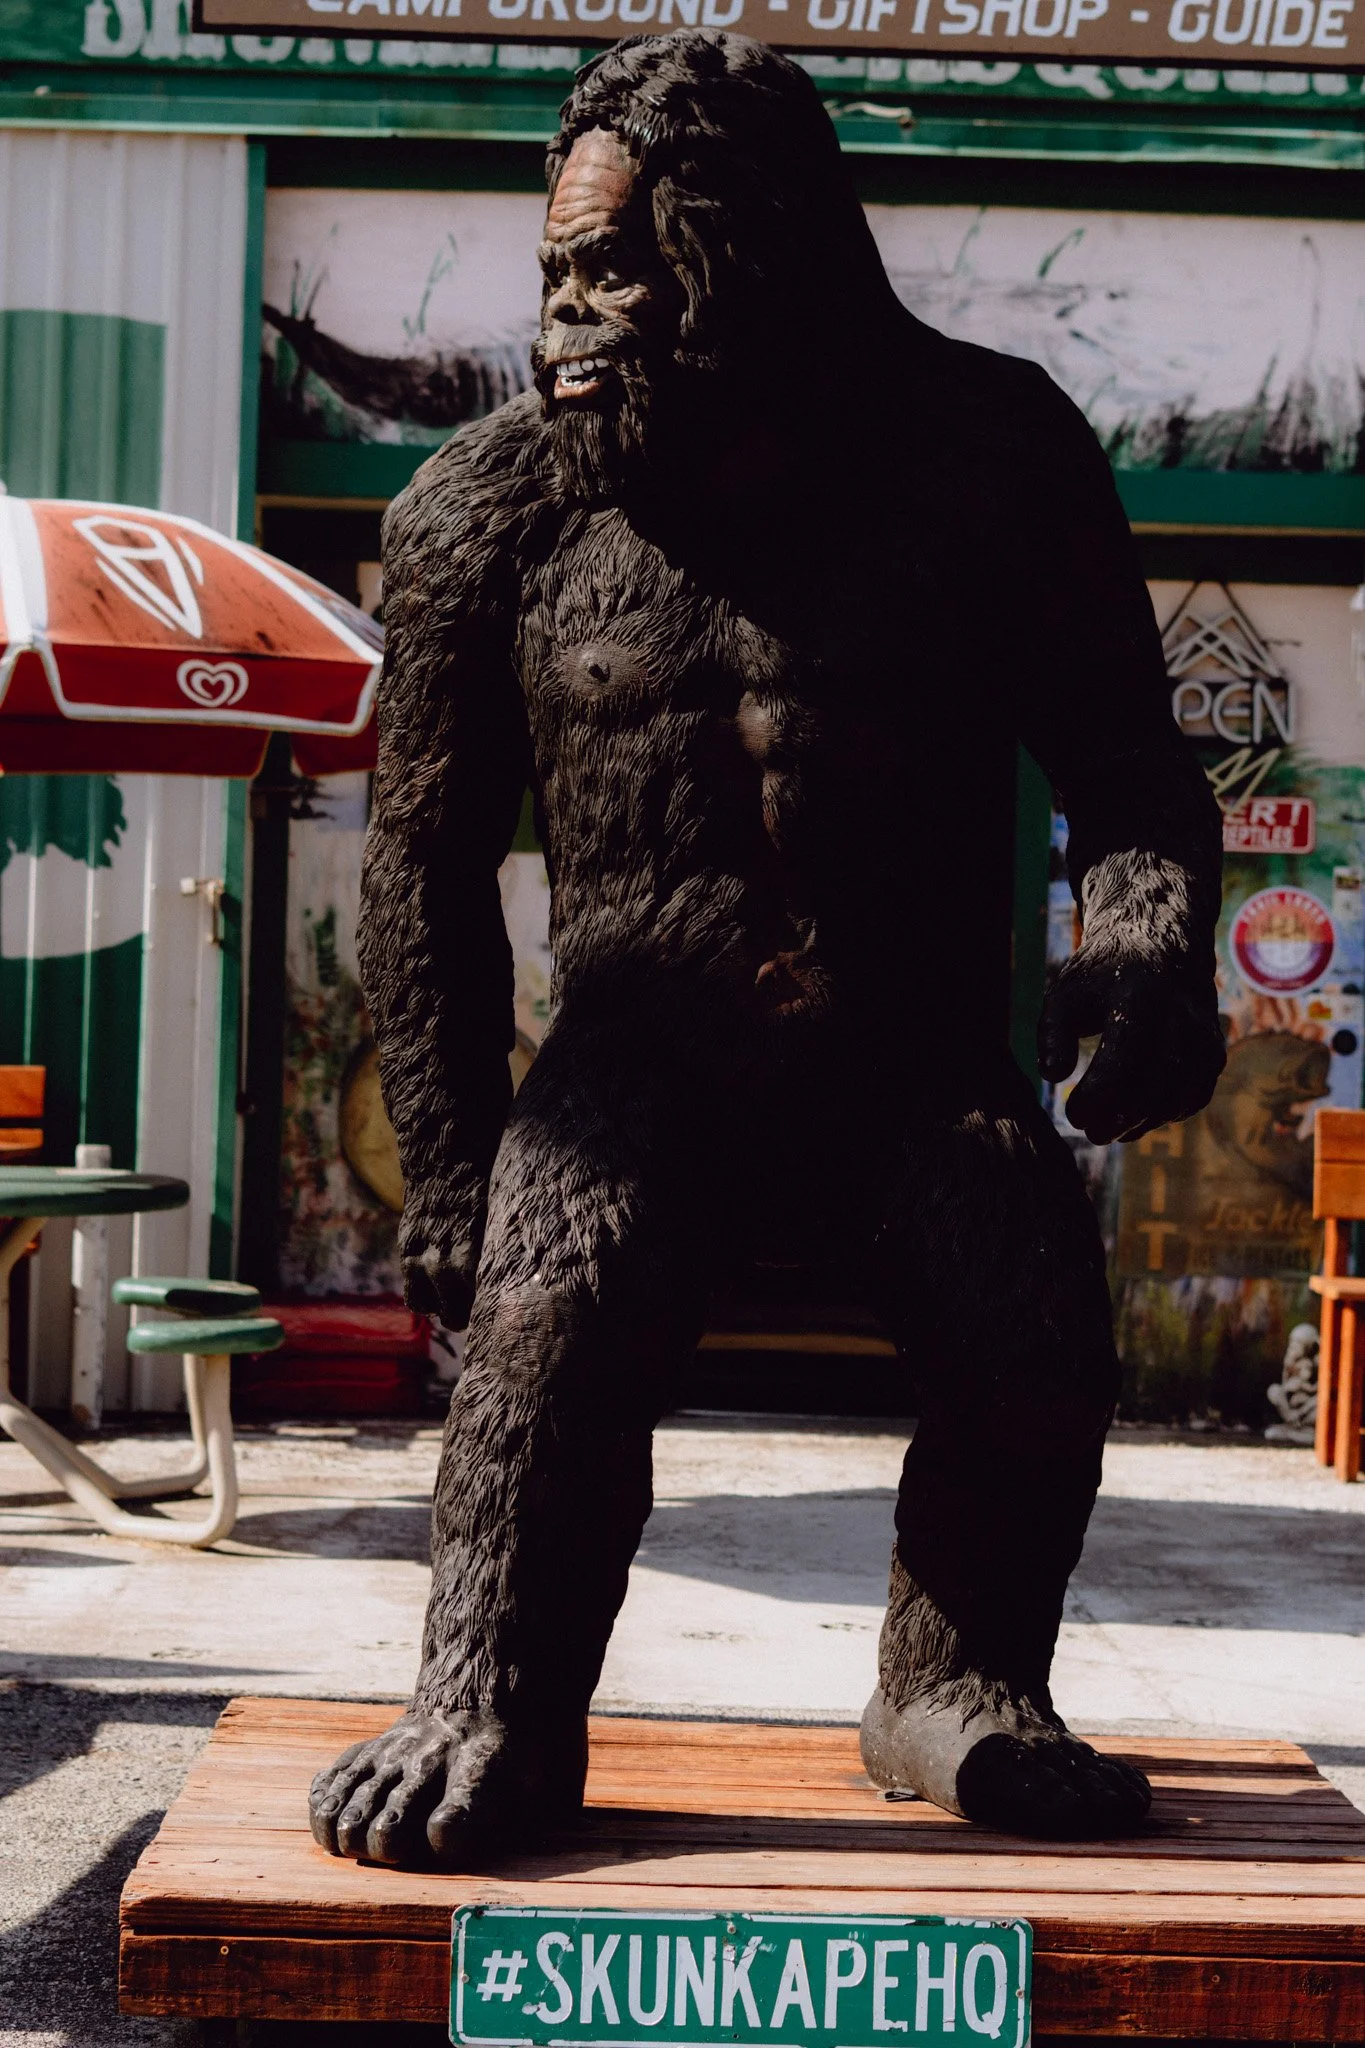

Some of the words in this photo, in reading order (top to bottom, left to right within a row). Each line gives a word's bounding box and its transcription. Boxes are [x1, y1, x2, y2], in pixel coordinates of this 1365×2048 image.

[807, 0, 1108, 38] GIFTSHOP
[1168, 0, 1354, 48] GUIDE
[1172, 681, 1296, 743] PEN
[476, 1931, 1007, 2039] #SKUNKAPEHQ
